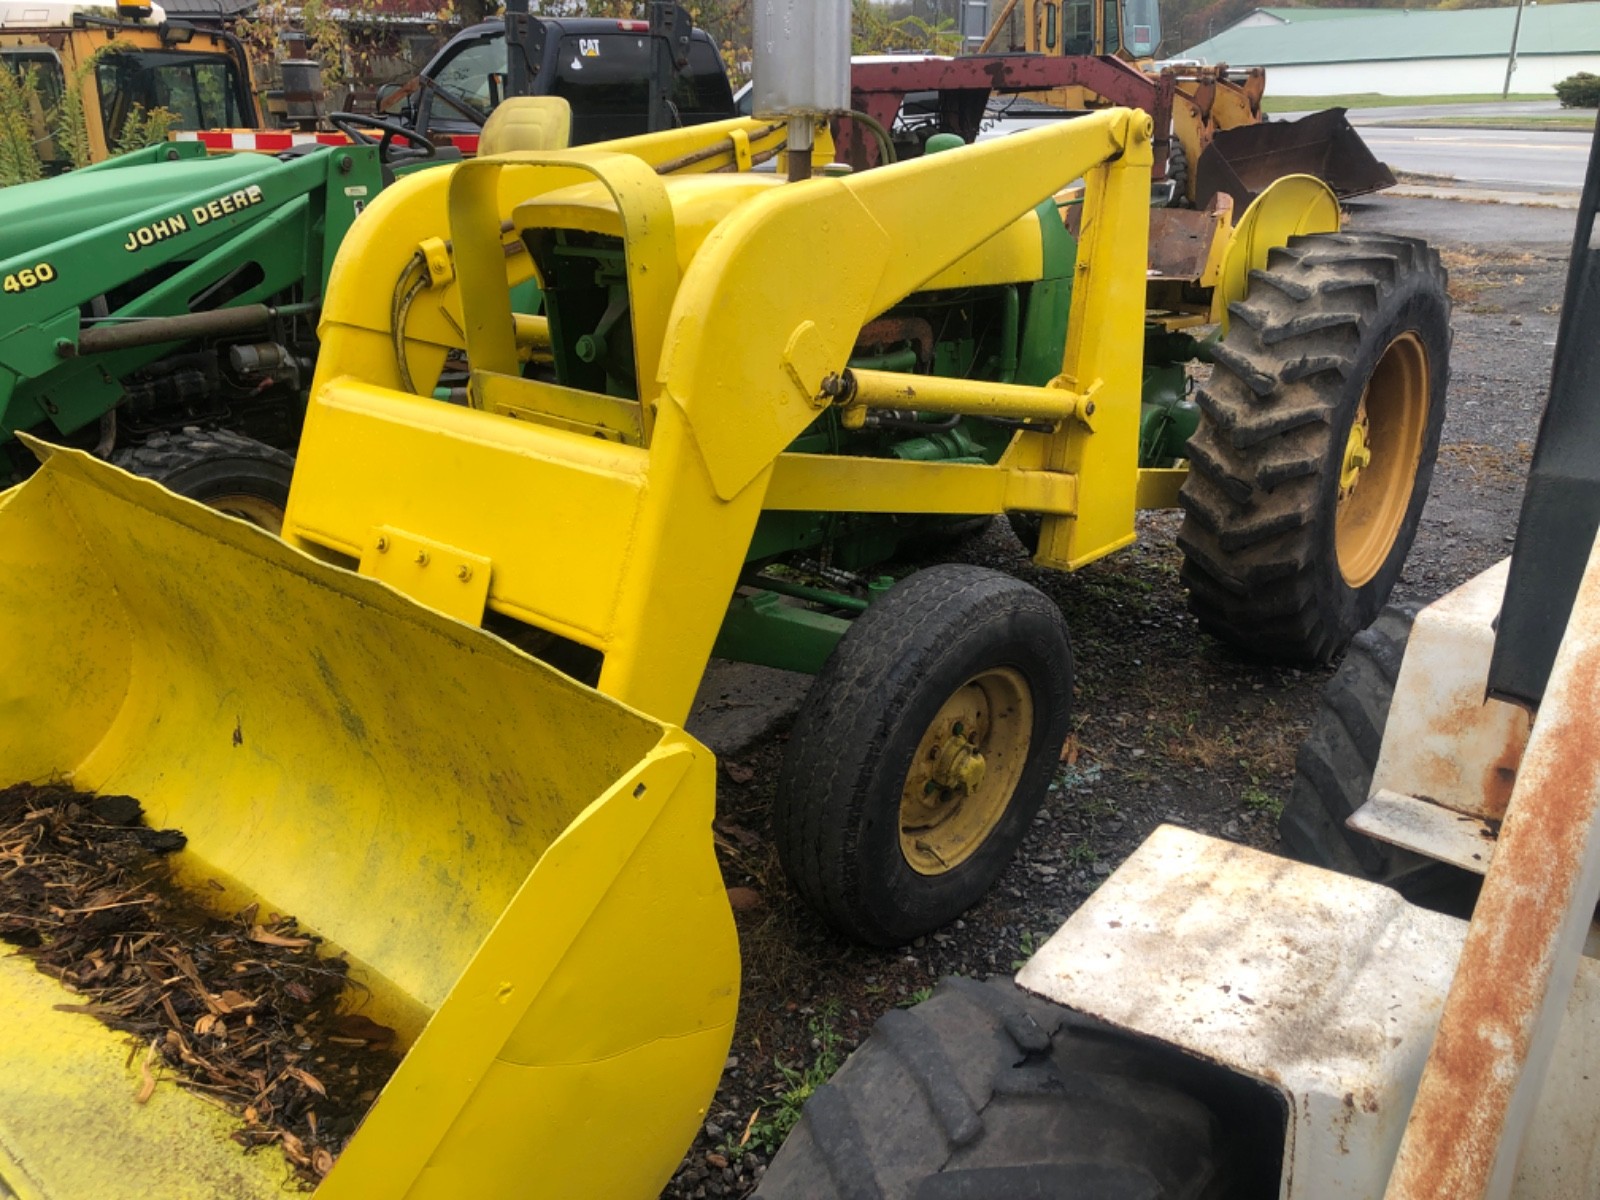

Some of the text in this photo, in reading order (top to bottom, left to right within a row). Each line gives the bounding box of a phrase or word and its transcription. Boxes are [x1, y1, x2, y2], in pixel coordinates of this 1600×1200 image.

[579, 39, 600, 56] CAT
[124, 184, 263, 251] JOHN DEERE
[4, 263, 55, 292] 460
